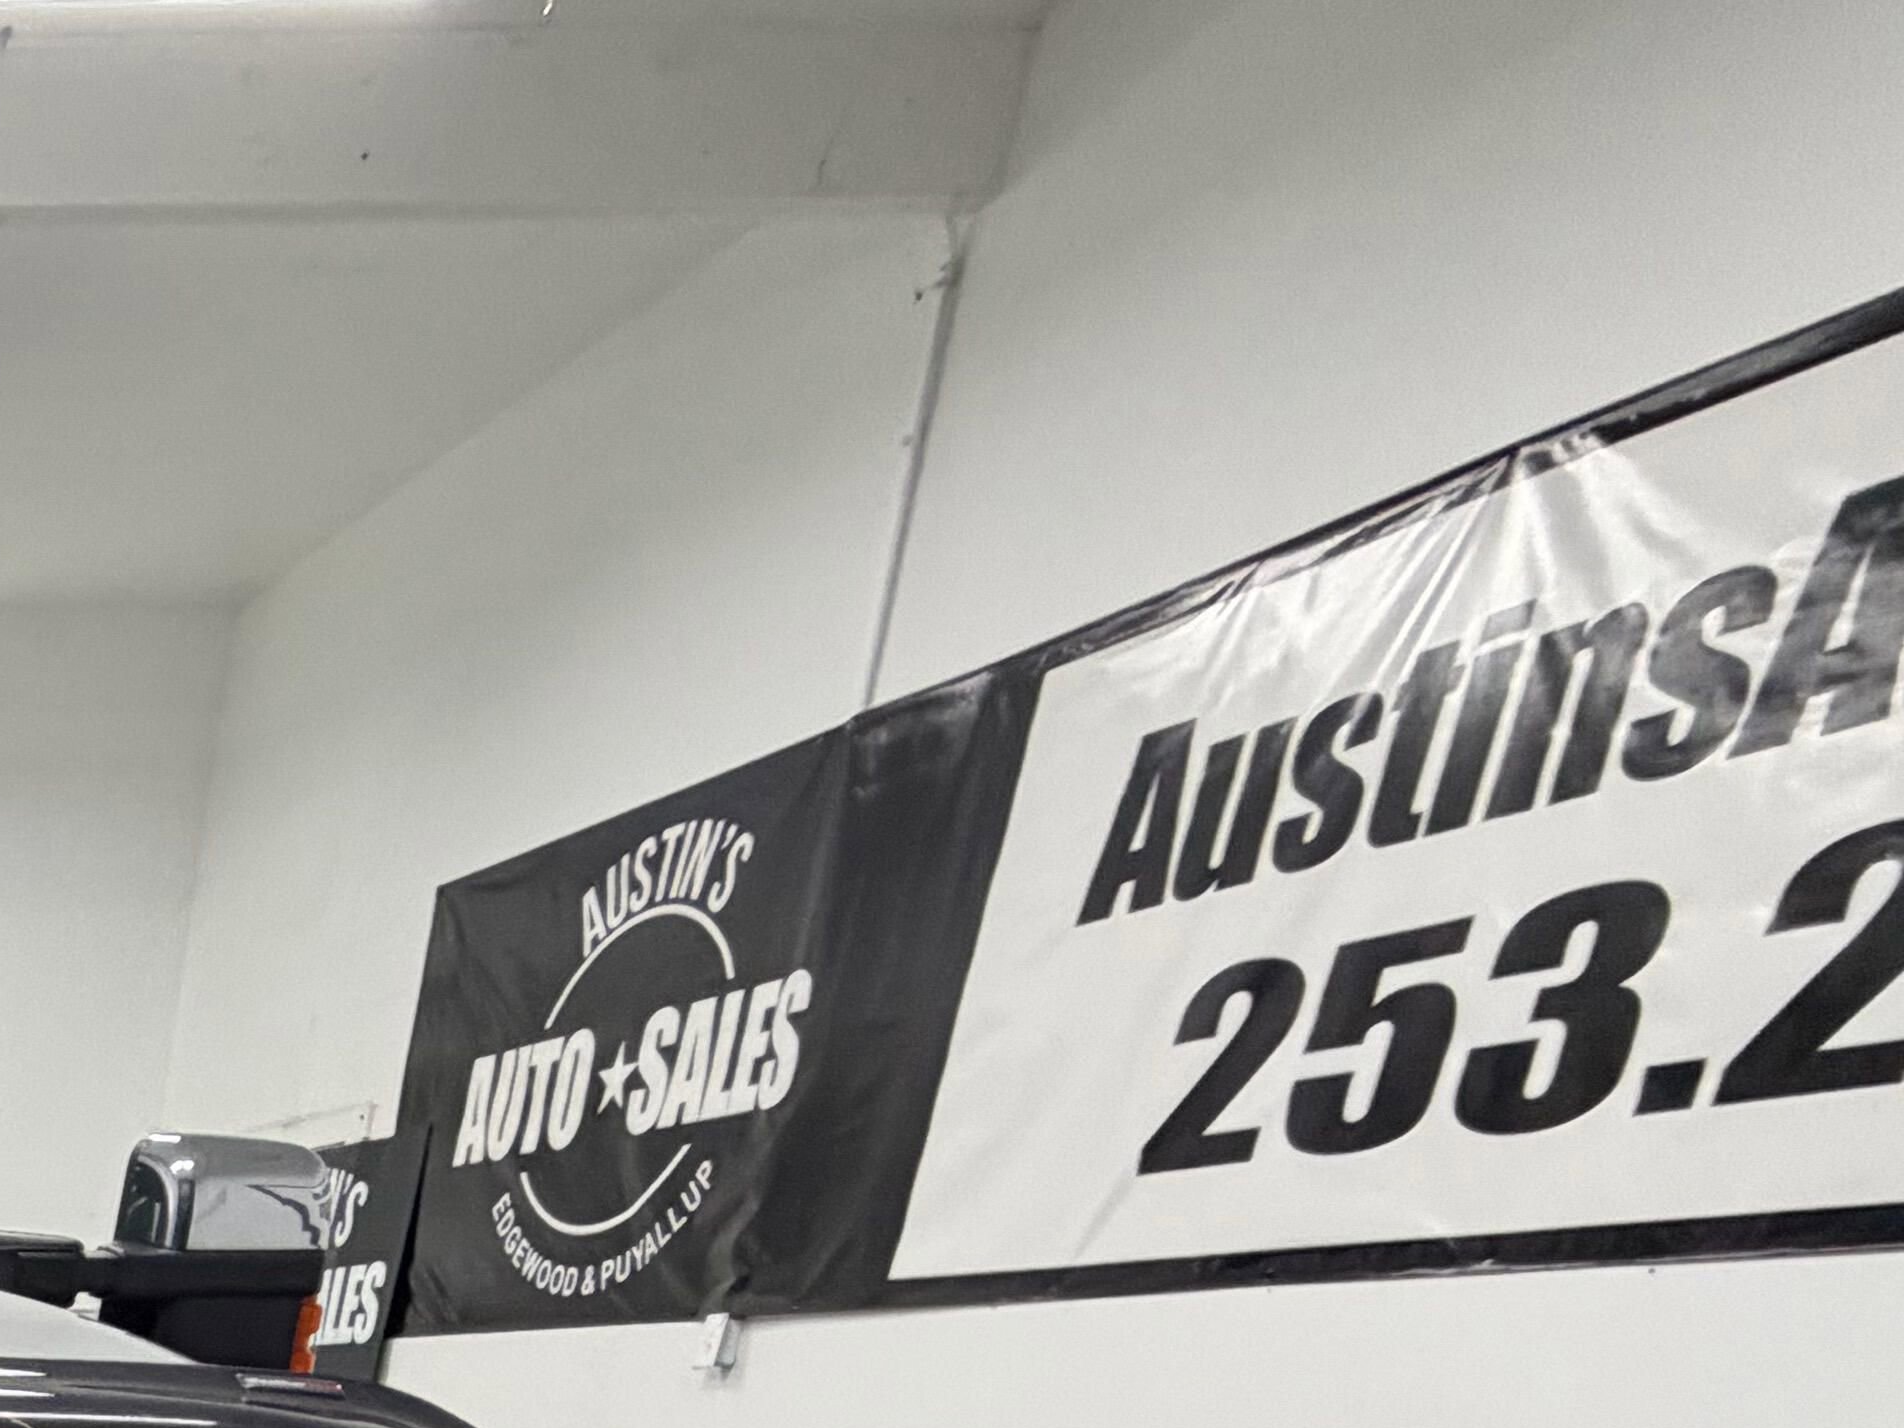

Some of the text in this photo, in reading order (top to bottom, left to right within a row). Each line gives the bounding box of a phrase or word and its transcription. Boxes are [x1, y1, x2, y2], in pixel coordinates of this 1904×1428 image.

[581, 818, 756, 957] AUSTIN'S
[452, 968, 814, 1168] AUTO SALES
[491, 1159, 713, 1298] EDGEWOOD & PUYALLUP
